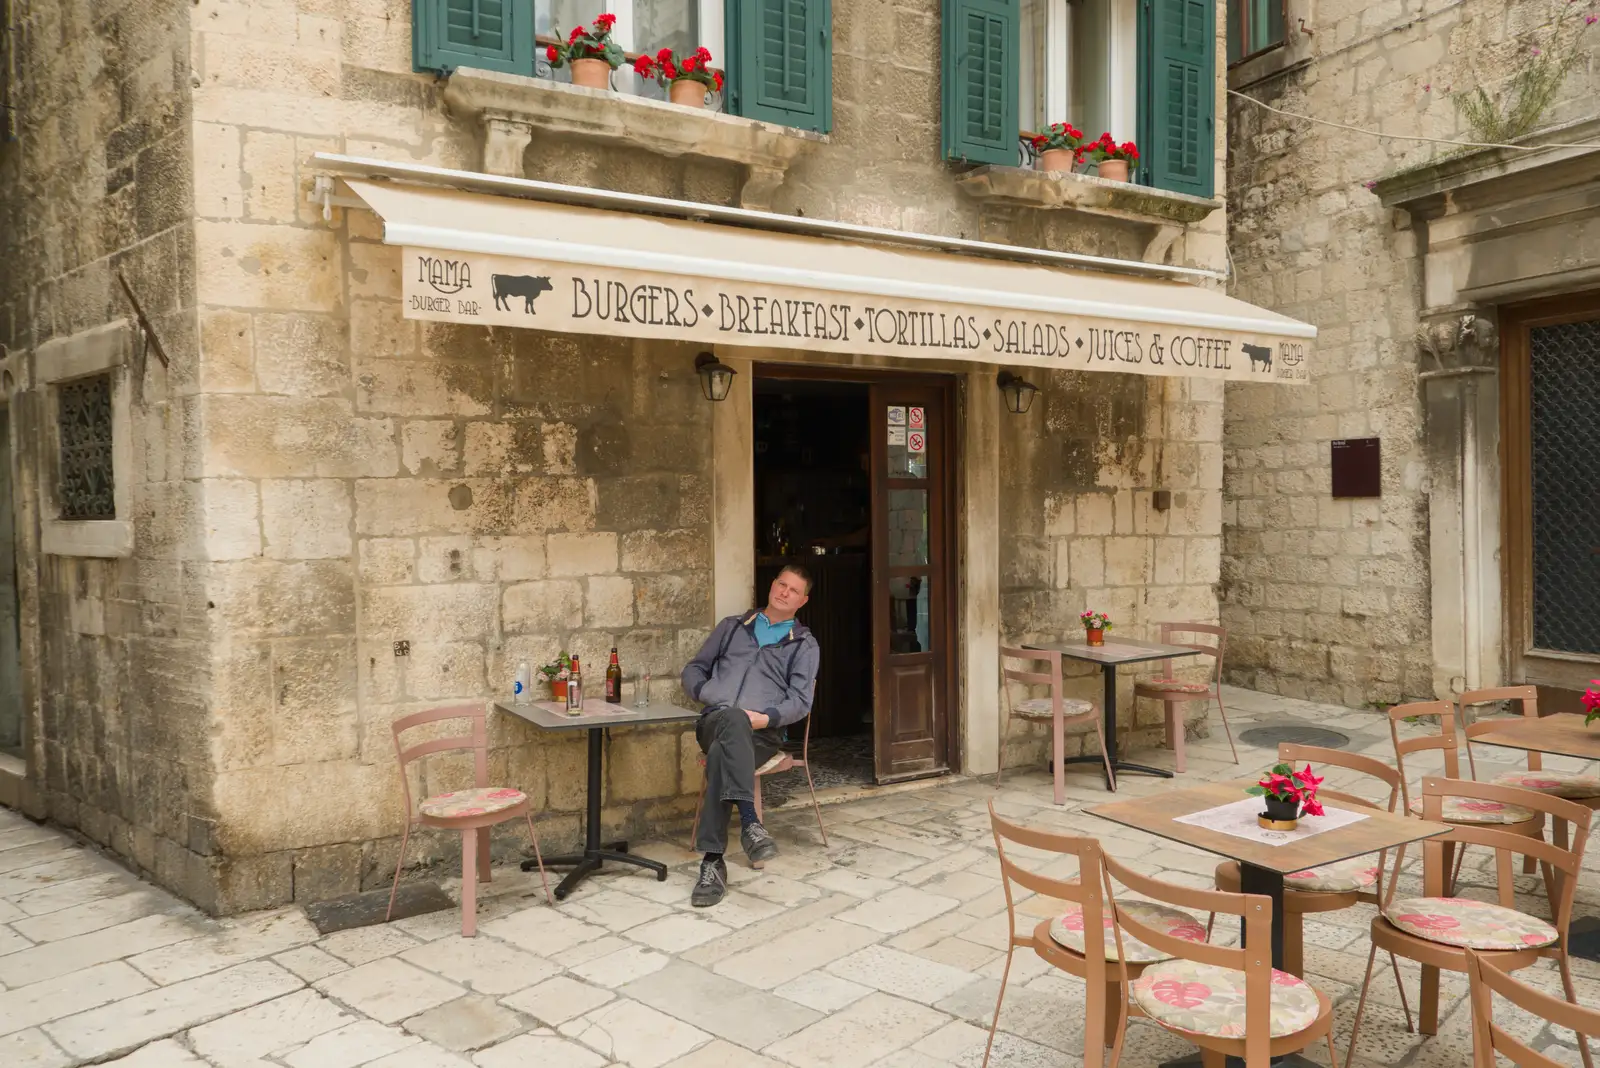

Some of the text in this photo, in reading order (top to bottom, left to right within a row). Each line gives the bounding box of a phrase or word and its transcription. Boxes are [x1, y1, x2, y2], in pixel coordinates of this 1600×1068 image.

[418, 256, 472, 294] MAMA
[572, 277, 1231, 370] BURGERS BREAKFAST TORTILLAS SALADS JUICES & COFFEE
[1279, 342, 1304, 366] MAMA
